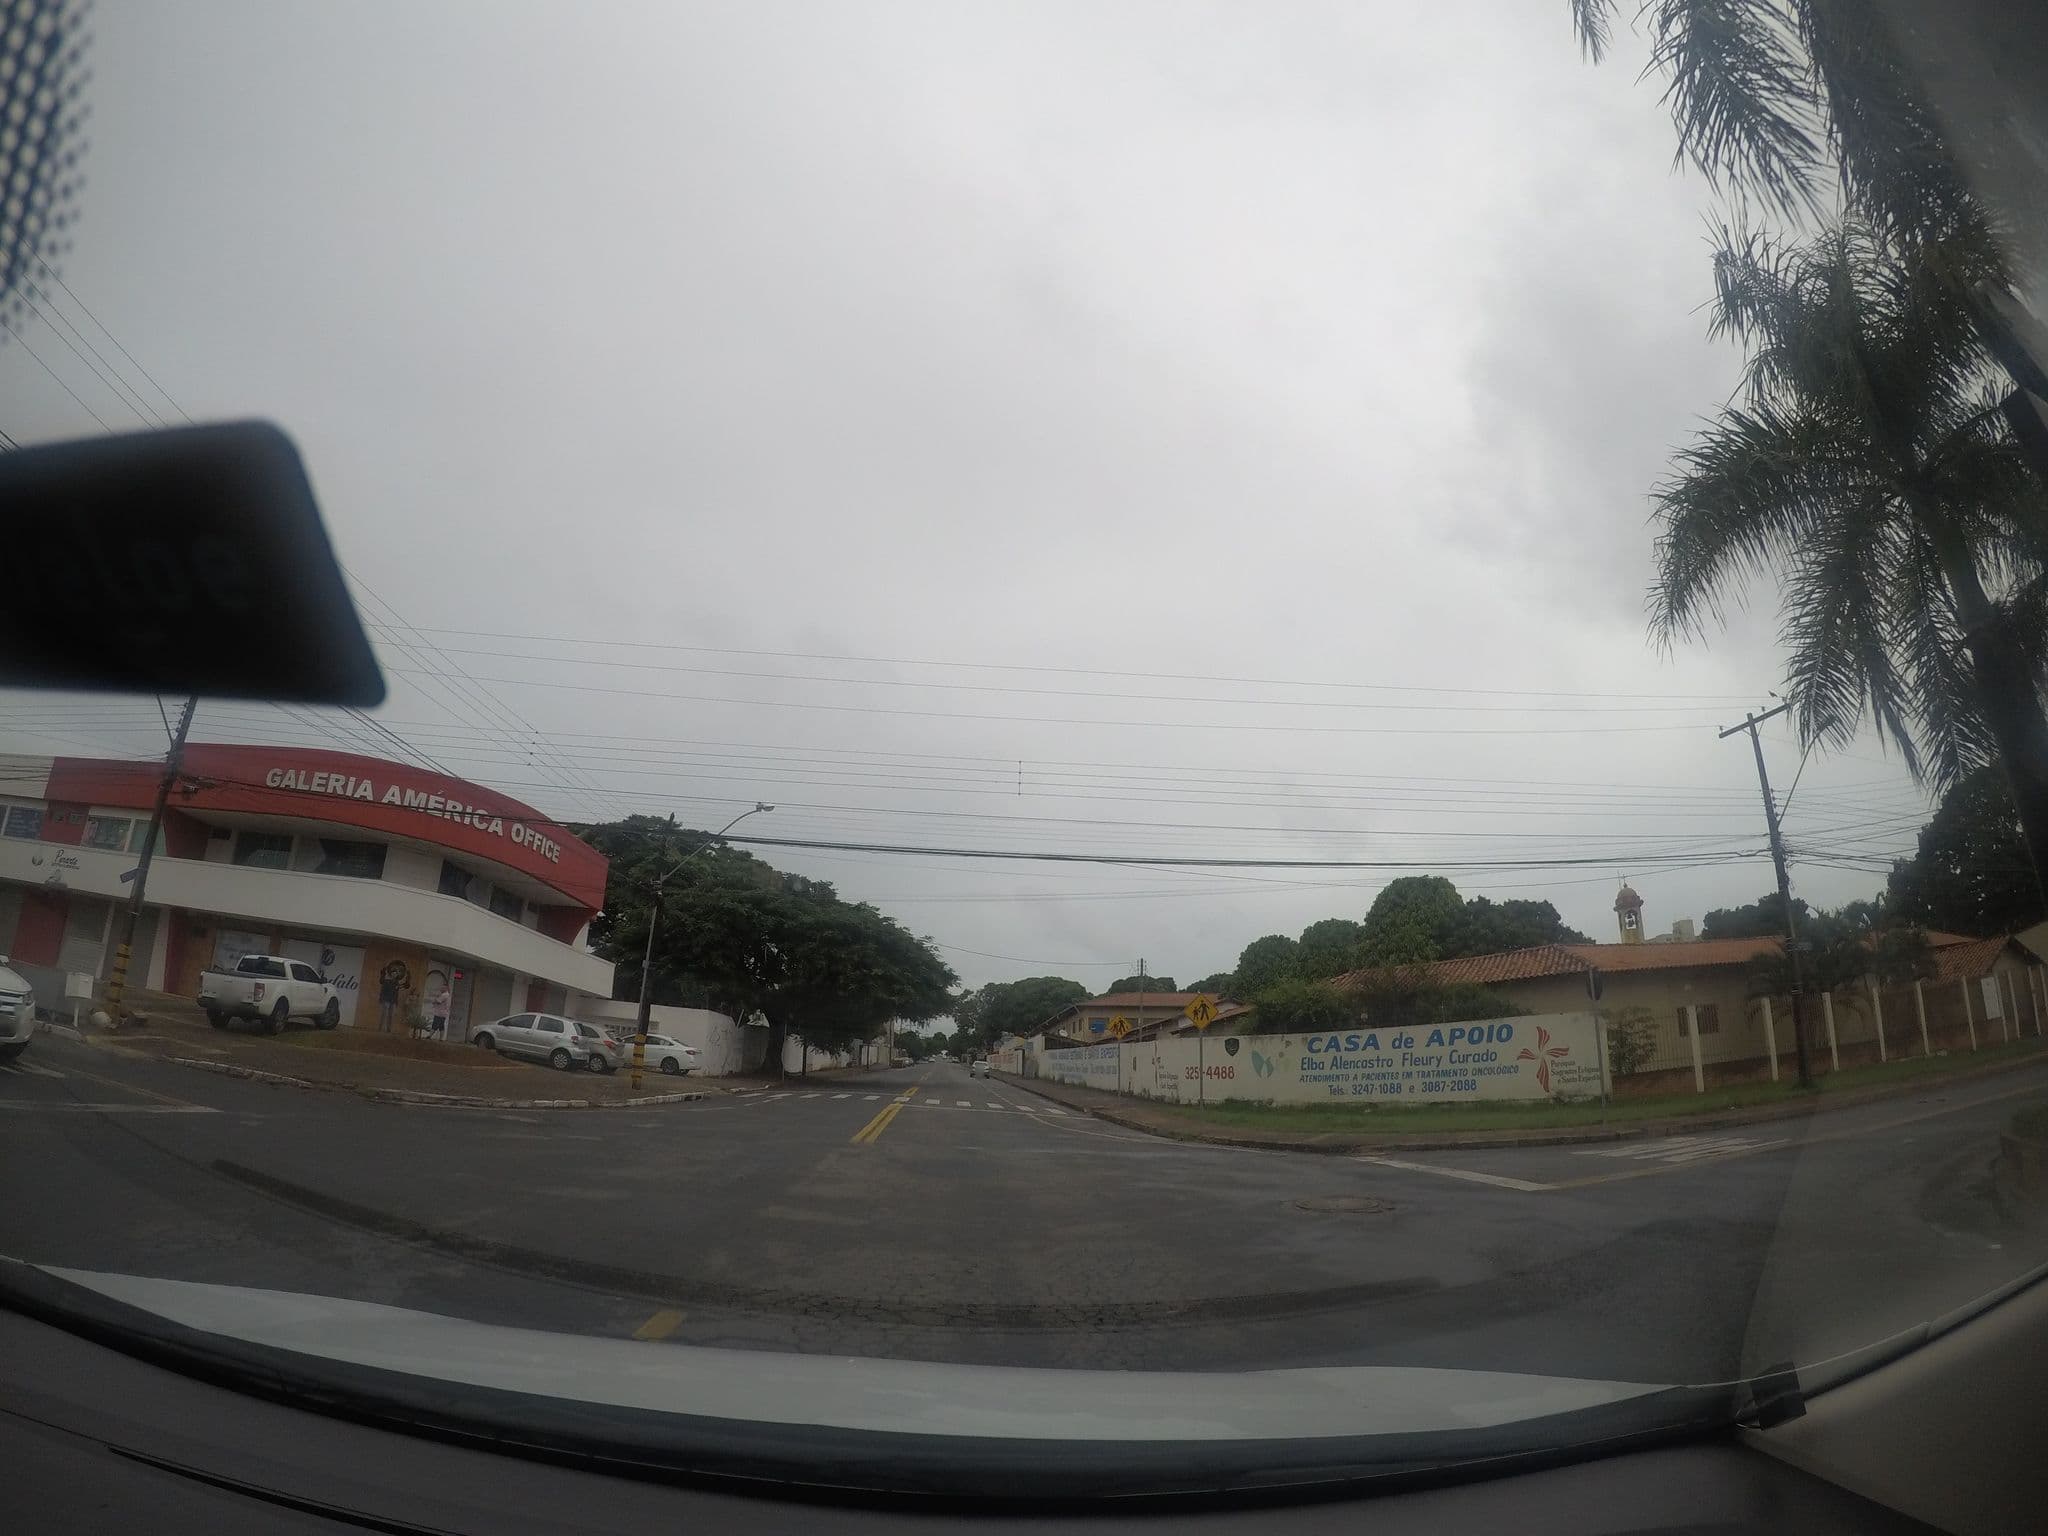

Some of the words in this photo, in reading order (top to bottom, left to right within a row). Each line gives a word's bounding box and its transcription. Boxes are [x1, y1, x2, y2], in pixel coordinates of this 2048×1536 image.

[266, 768, 374, 801] GALERIA
[382, 784, 503, 837] AMÉRICA
[511, 823, 561, 864] OFFICE
[1307, 1033, 1380, 1054] CASA
[1391, 1031, 1415, 1050] de
[1425, 1023, 1514, 1048] APOIO
[1300, 1056, 1325, 1071] Elba
[1330, 1055, 1393, 1071] Alencastro
[1402, 1052, 1443, 1068] Fleury
[1449, 1049, 1498, 1065] Curado
[1299, 1073, 1350, 1083] ATENDIMENTO
[1352, 1073, 1359, 1082] A
[1361, 1071, 1400, 1081] PACIENTES
[1402, 1071, 1413, 1079] EM
[1417, 1067, 1468, 1079] TRATAMENTO
[1351, 1082, 1402, 1096] 3247-1088
[1408, 1084, 1415, 1094] e
[1421, 1079, 1477, 1093] 3087-2088
